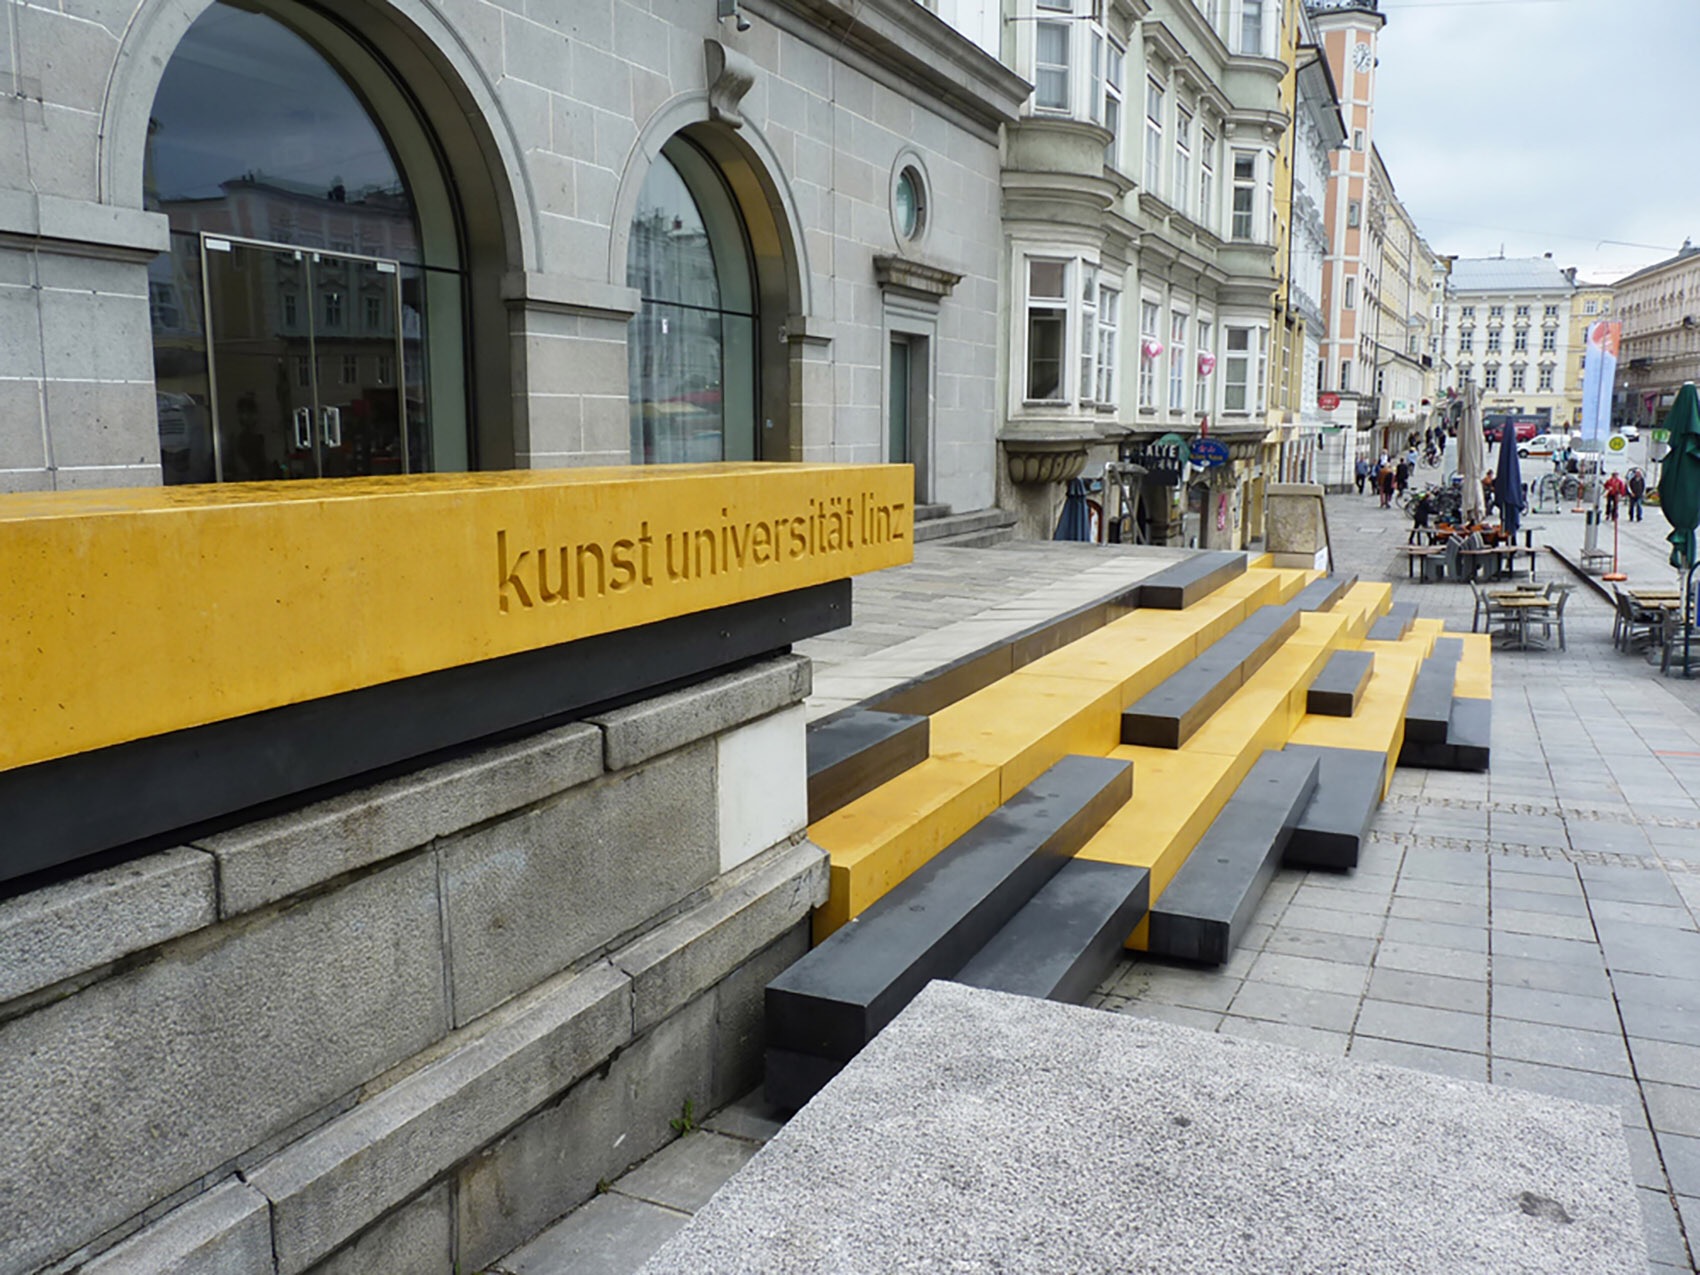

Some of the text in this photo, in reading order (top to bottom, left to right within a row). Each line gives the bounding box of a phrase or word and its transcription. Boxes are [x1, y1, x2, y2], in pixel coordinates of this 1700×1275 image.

[497, 492, 904, 614] kunst universität linz
